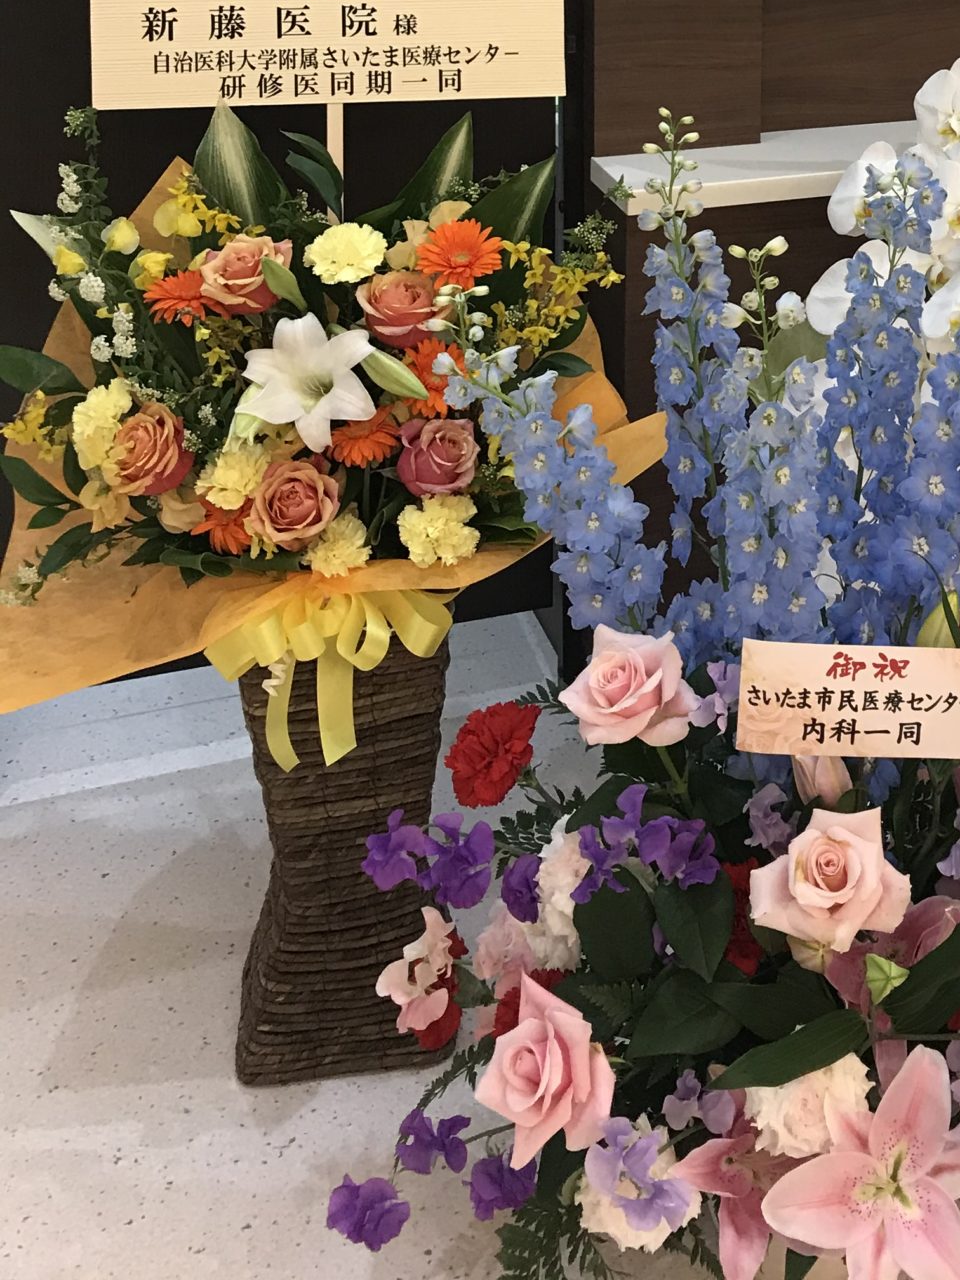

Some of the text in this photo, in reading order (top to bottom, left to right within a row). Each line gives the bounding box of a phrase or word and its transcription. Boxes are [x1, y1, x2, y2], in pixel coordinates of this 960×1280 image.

[153, 43, 519, 74] 自治医科大学附属さいたま医療センター
[219, 68, 462, 99] 研修医同期一同
[826, 651, 910, 683] 御祝
[801, 718, 922, 746] 内科一同
